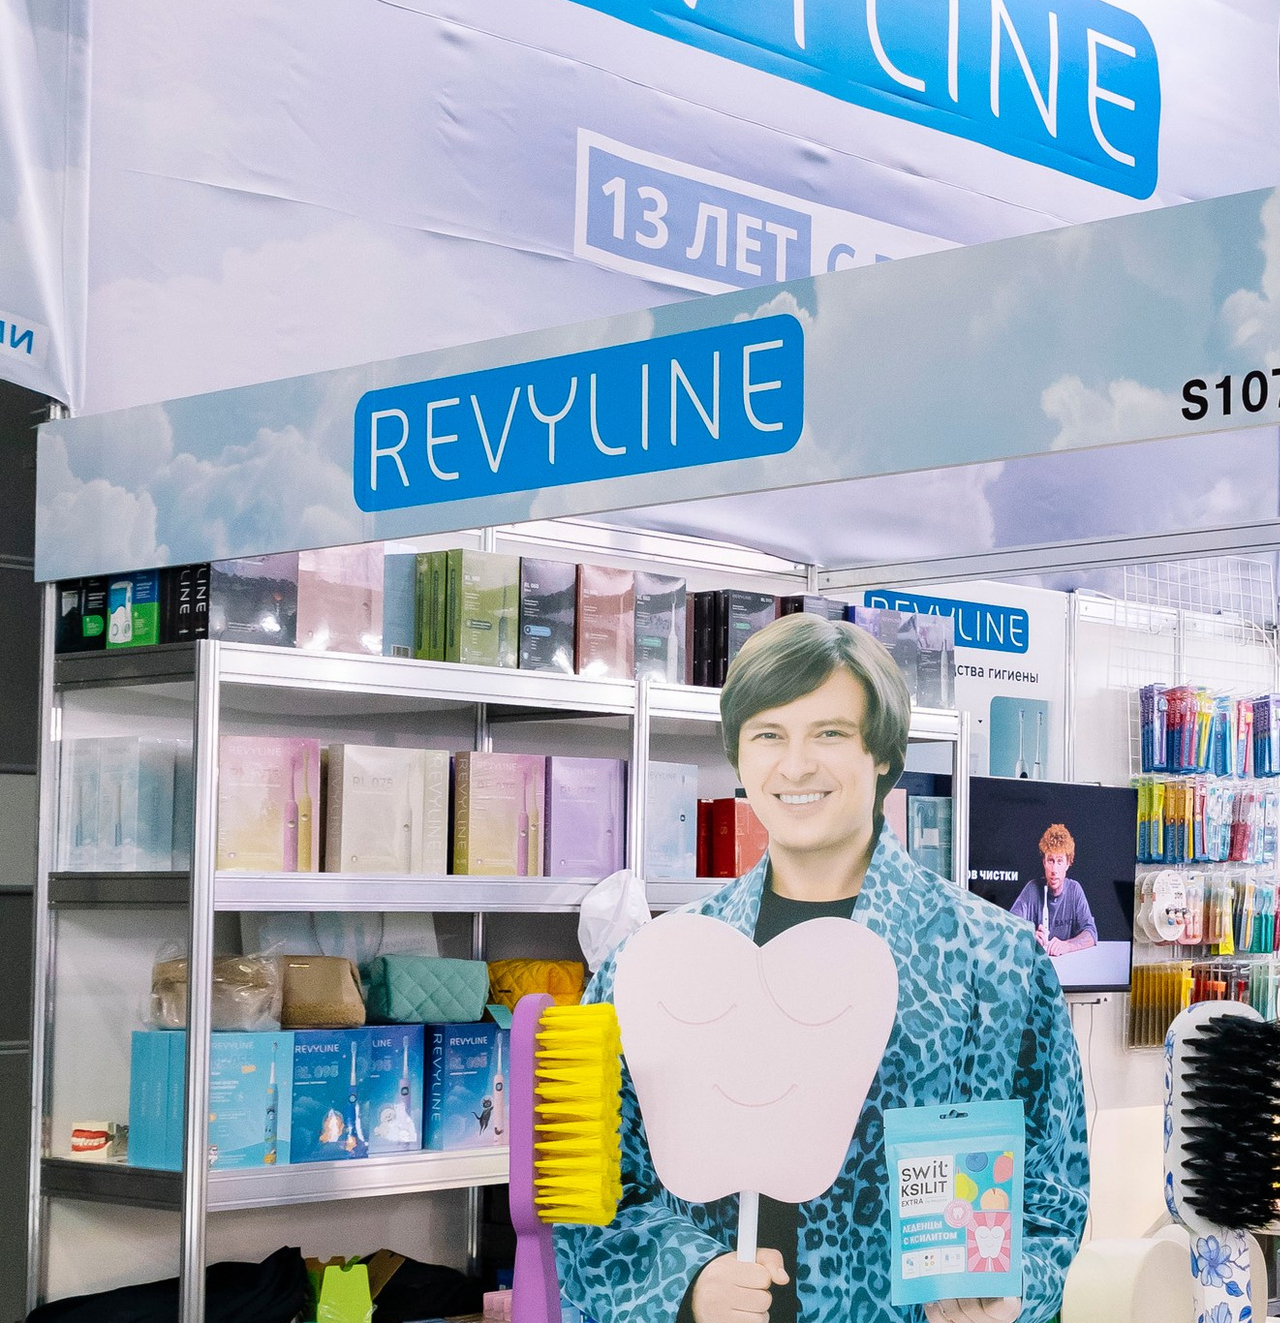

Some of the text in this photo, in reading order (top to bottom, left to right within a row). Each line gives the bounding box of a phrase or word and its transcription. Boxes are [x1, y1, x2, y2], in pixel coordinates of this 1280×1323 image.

[603, 176, 668, 248] 13
[685, 205, 801, 281] ЛЕТ
[369, 339, 784, 491] REVYLINE
[988, 668, 1039, 683] гигиены
[457, 758, 469, 851] REVYLINE
[294, 1043, 340, 1054] REVYLINE
[450, 1036, 488, 1046] REVYLINE
[432, 1033, 443, 1122] REVYLINE
[901, 1181, 947, 1197] KSILIT
[901, 1198, 924, 1207] EXTRA
[902, 1221, 943, 1234] ЛЕДЕНЦЫ
[910, 1232, 958, 1245] КСИЛИТОМ
